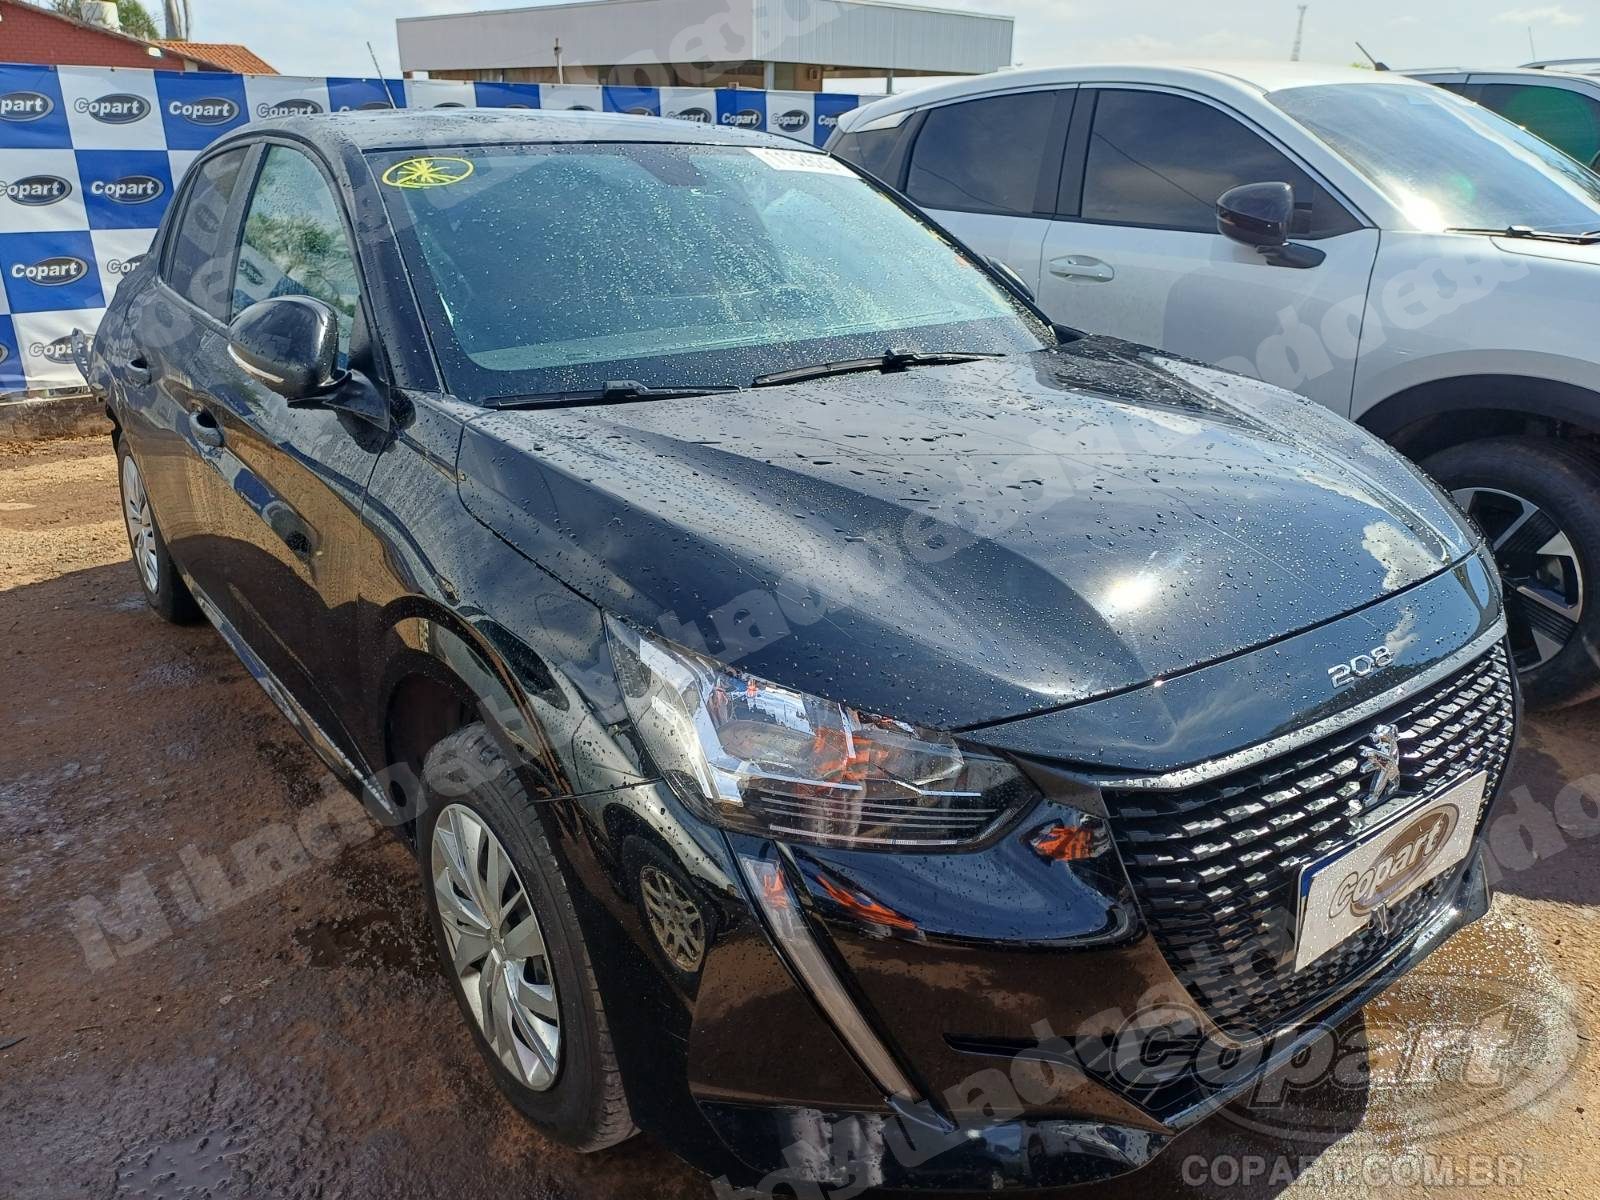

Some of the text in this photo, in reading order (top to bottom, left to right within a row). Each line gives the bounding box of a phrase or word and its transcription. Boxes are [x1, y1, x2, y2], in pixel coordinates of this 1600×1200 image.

[0, 97, 43, 113] part
[74, 97, 140, 115] Copart
[168, 100, 230, 118] Copart
[721, 112, 757, 125] Copart
[771, 112, 805, 125] Copart
[818, 115, 838, 127] Cop
[91, 180, 154, 197] Copart
[11, 262, 77, 278] Copart
[29, 338, 94, 357] Copat
[1328, 645, 1394, 689] 208
[1328, 813, 1449, 919] Copart
